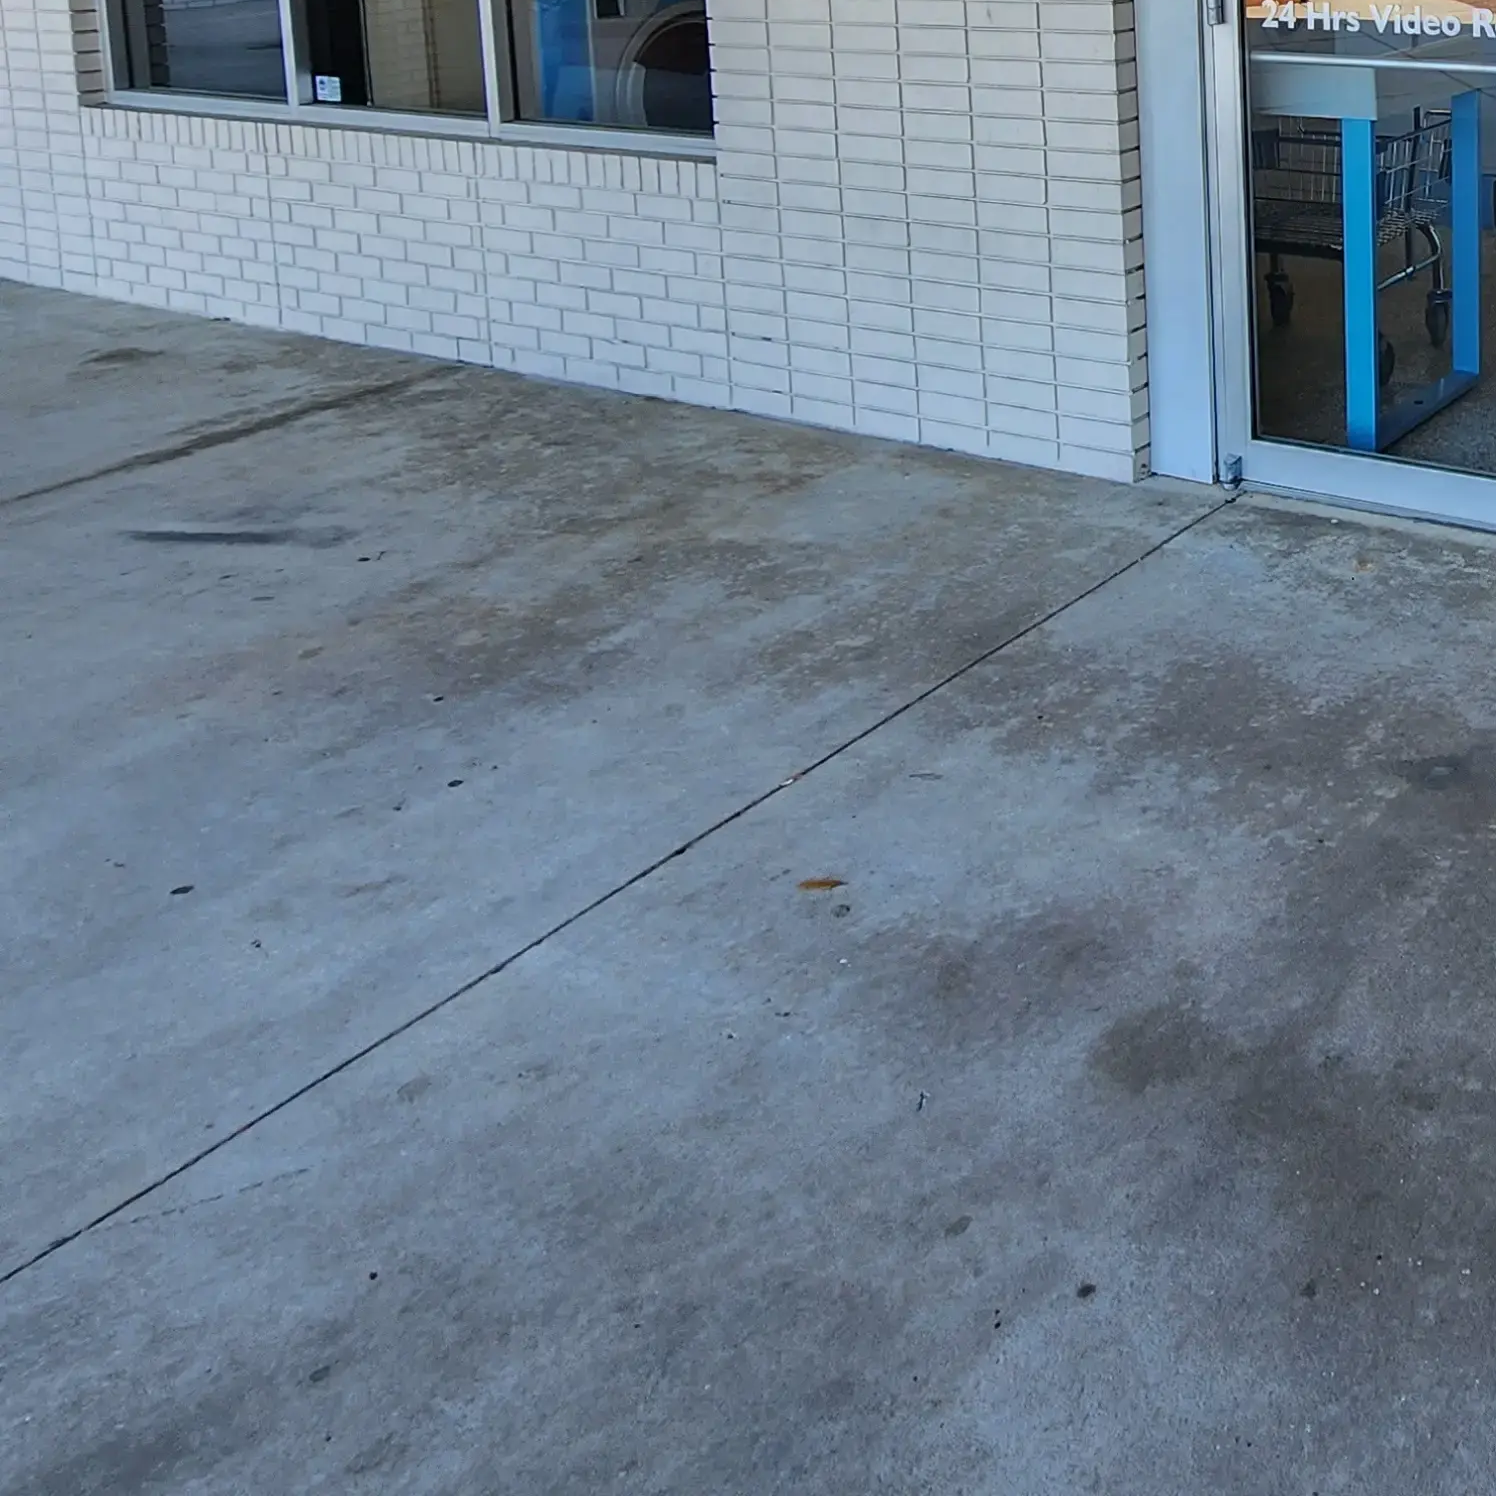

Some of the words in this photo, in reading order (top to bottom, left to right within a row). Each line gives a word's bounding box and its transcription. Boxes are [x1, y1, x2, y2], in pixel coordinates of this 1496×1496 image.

[1261, 0, 1297, 29] 24
[1307, 1, 1360, 32] Hrs
[1370, 4, 1461, 37] Video
